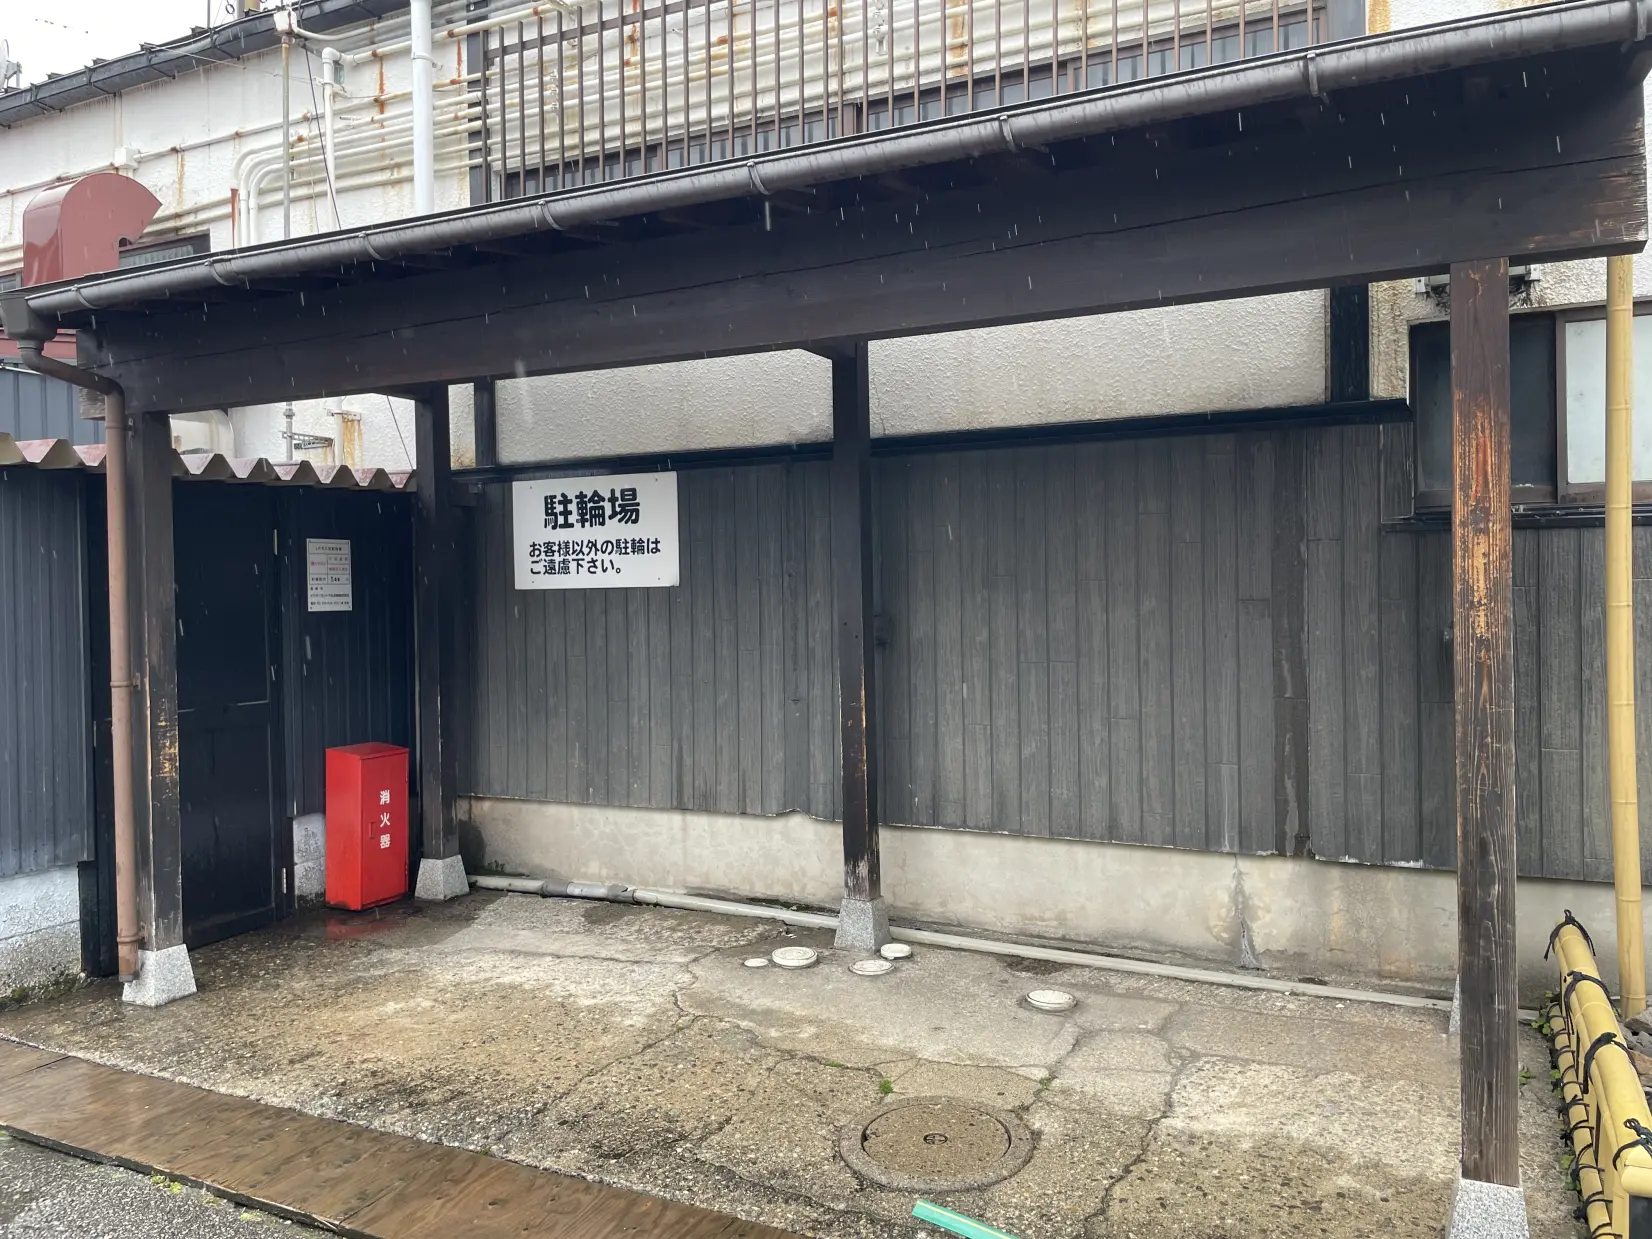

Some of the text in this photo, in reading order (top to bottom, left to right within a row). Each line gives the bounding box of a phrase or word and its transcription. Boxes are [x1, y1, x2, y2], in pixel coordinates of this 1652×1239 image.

[543, 487, 641, 531] 駐輪場
[529, 537, 661, 558] お客様以外の駐輪は
[530, 558, 622, 576] ご遠慮下さい。
[379, 789, 391, 849] 消火器
